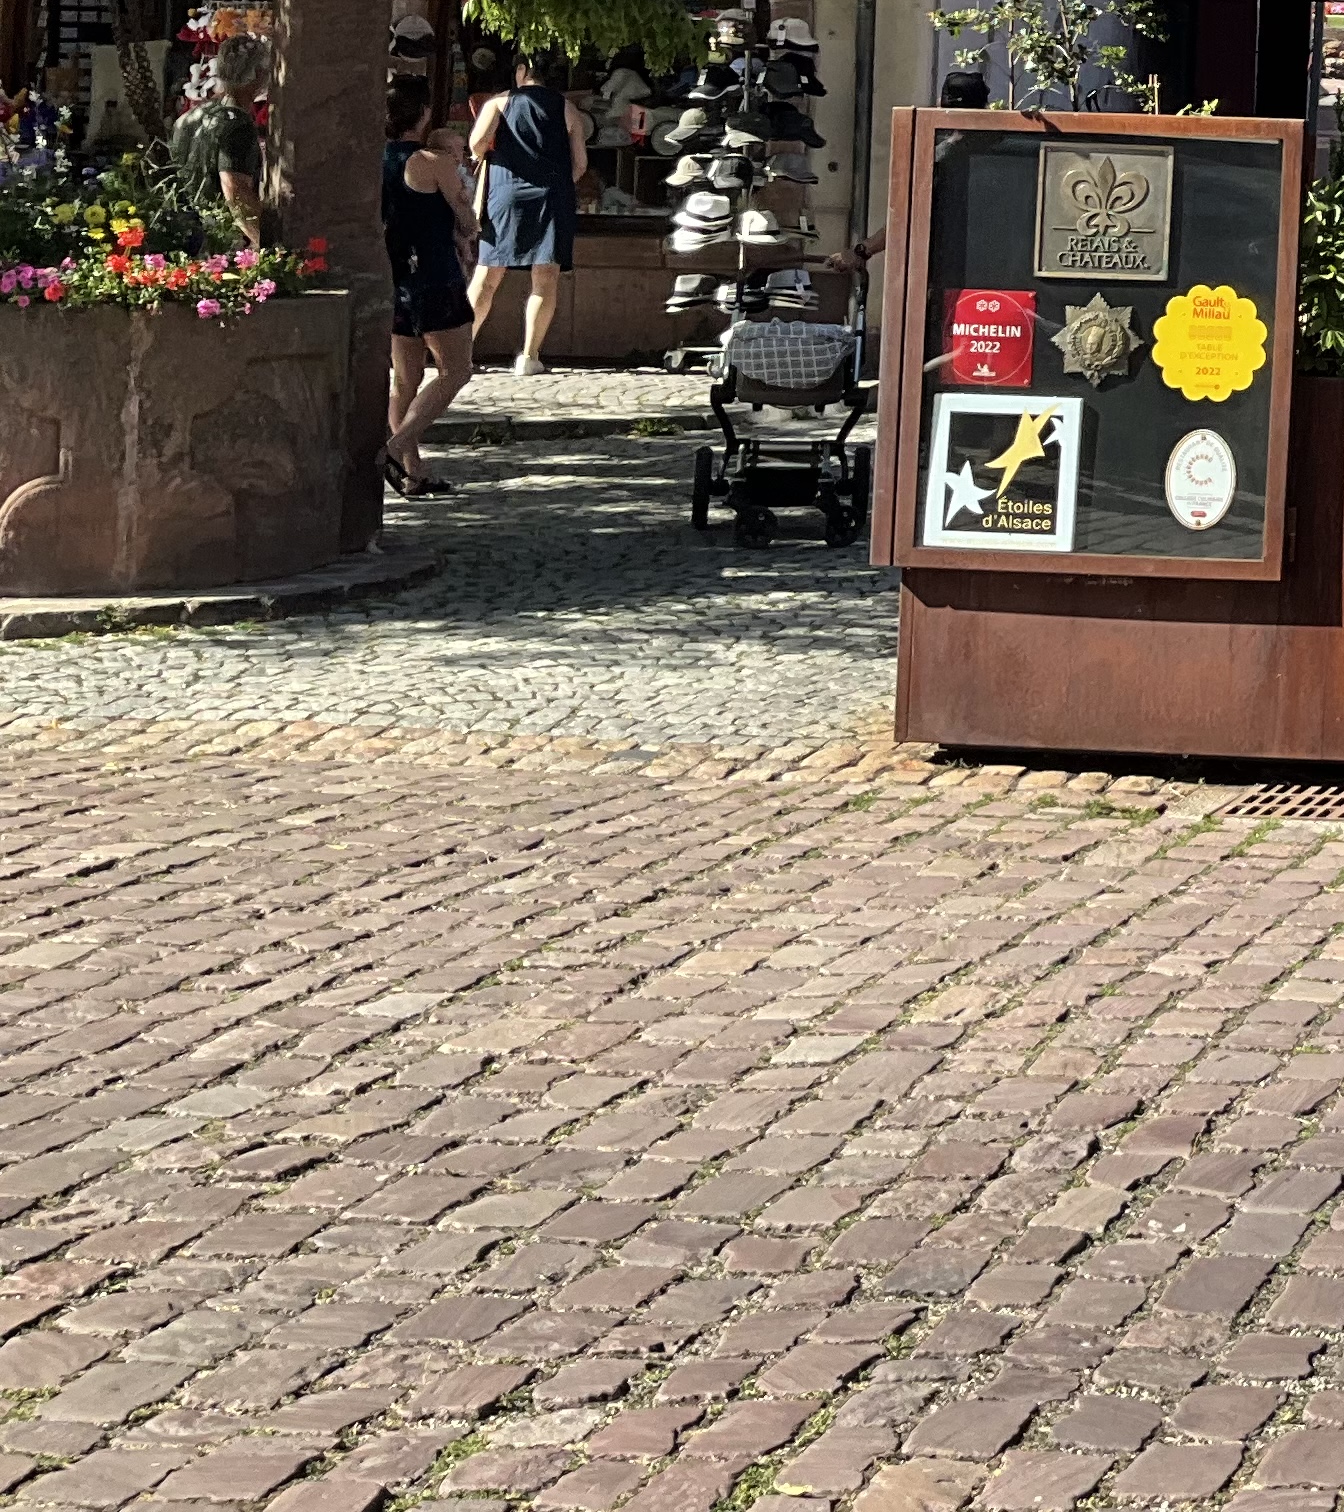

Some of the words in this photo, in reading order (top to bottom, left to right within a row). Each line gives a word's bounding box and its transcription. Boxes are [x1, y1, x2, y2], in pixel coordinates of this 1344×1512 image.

[1067, 236, 1122, 252] RELAIS
[1192, 307, 1231, 320] Millau
[952, 323, 1022, 338] MICHELIN
[969, 340, 1001, 354] 2022
[1195, 367, 1221, 375] 2022
[997, 495, 1053, 515] Étoiles
[982, 514, 1052, 530] d'Alsace
